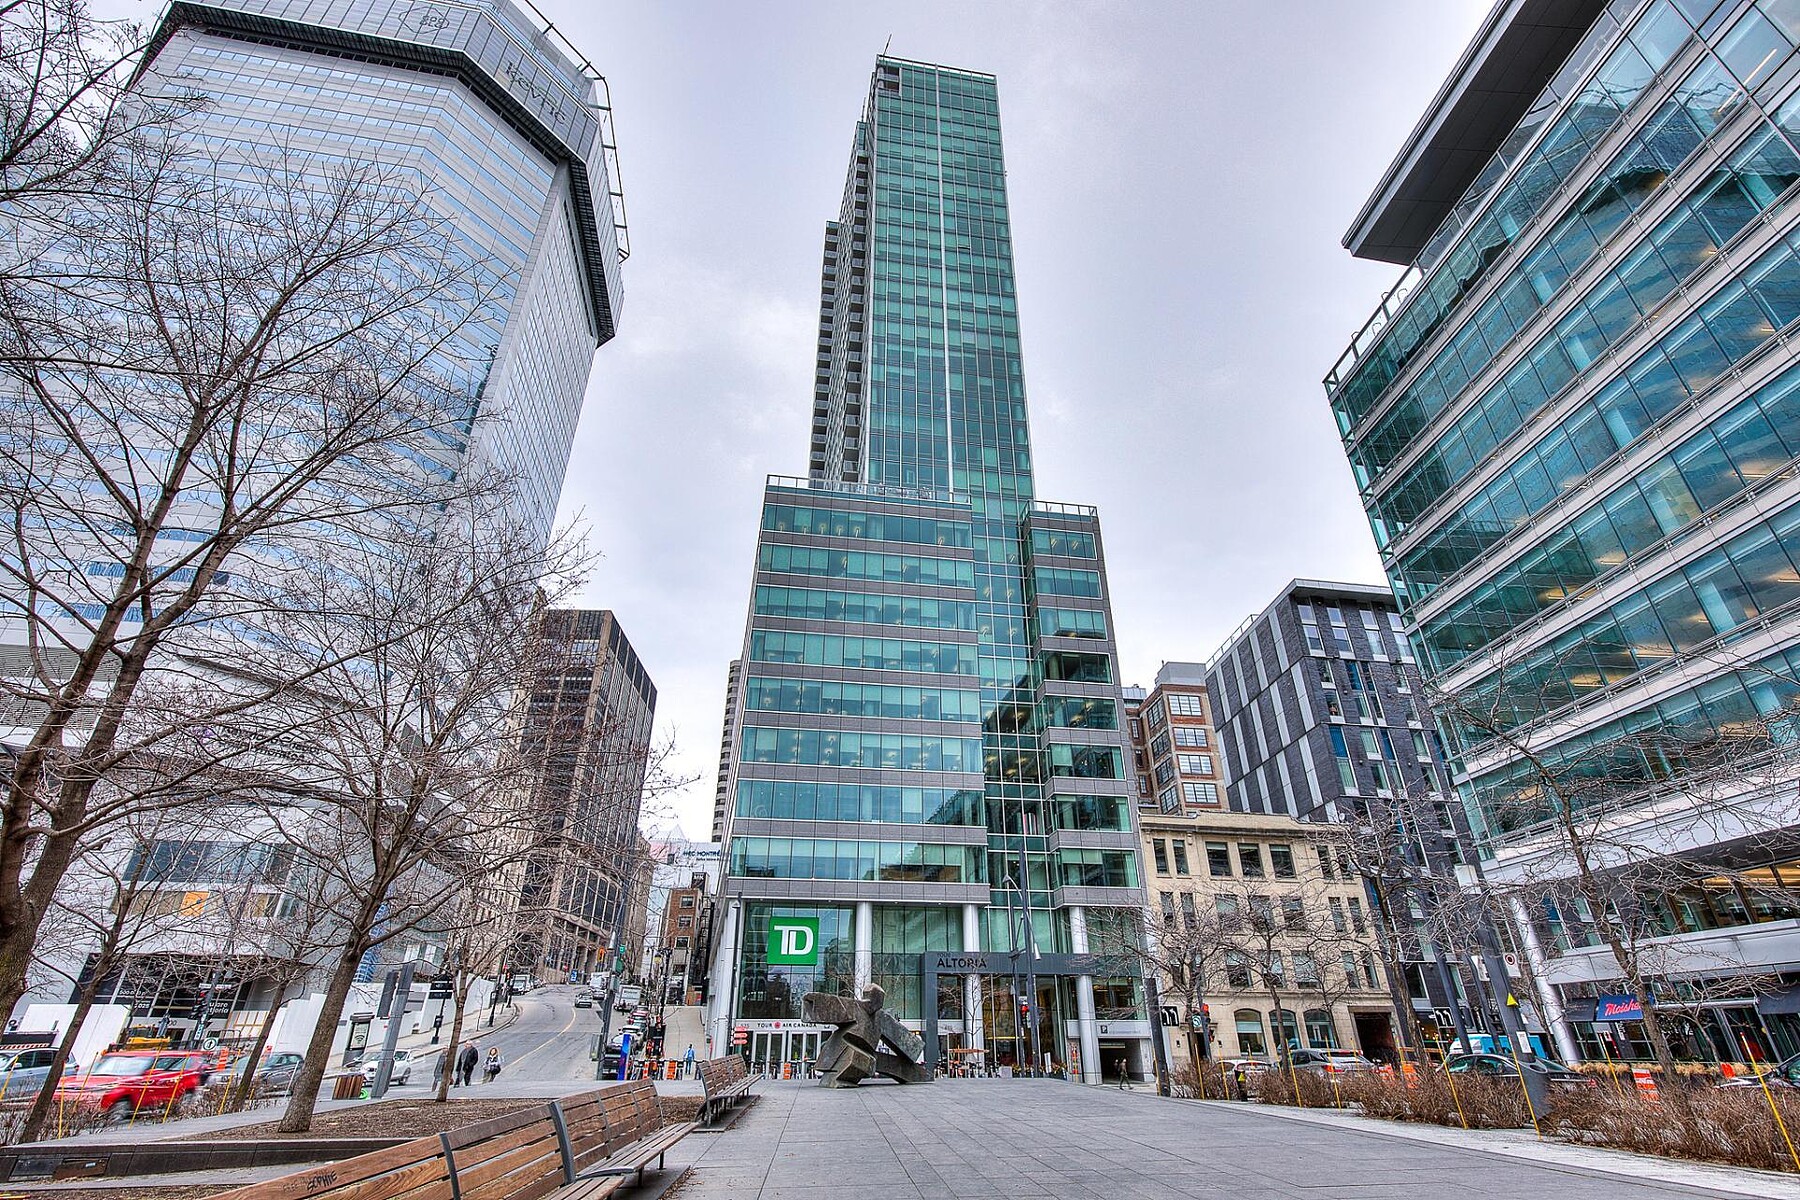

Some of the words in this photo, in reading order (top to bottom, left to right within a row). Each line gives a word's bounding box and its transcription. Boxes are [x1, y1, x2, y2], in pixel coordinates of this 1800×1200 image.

[697, 849, 720, 857] MONTRÉ
[774, 925, 814, 955] TD
[937, 958, 987, 968] ALTORIA
[1604, 999, 1642, 1017] Moishe
[307, 1170, 338, 1193] SOPHIE
